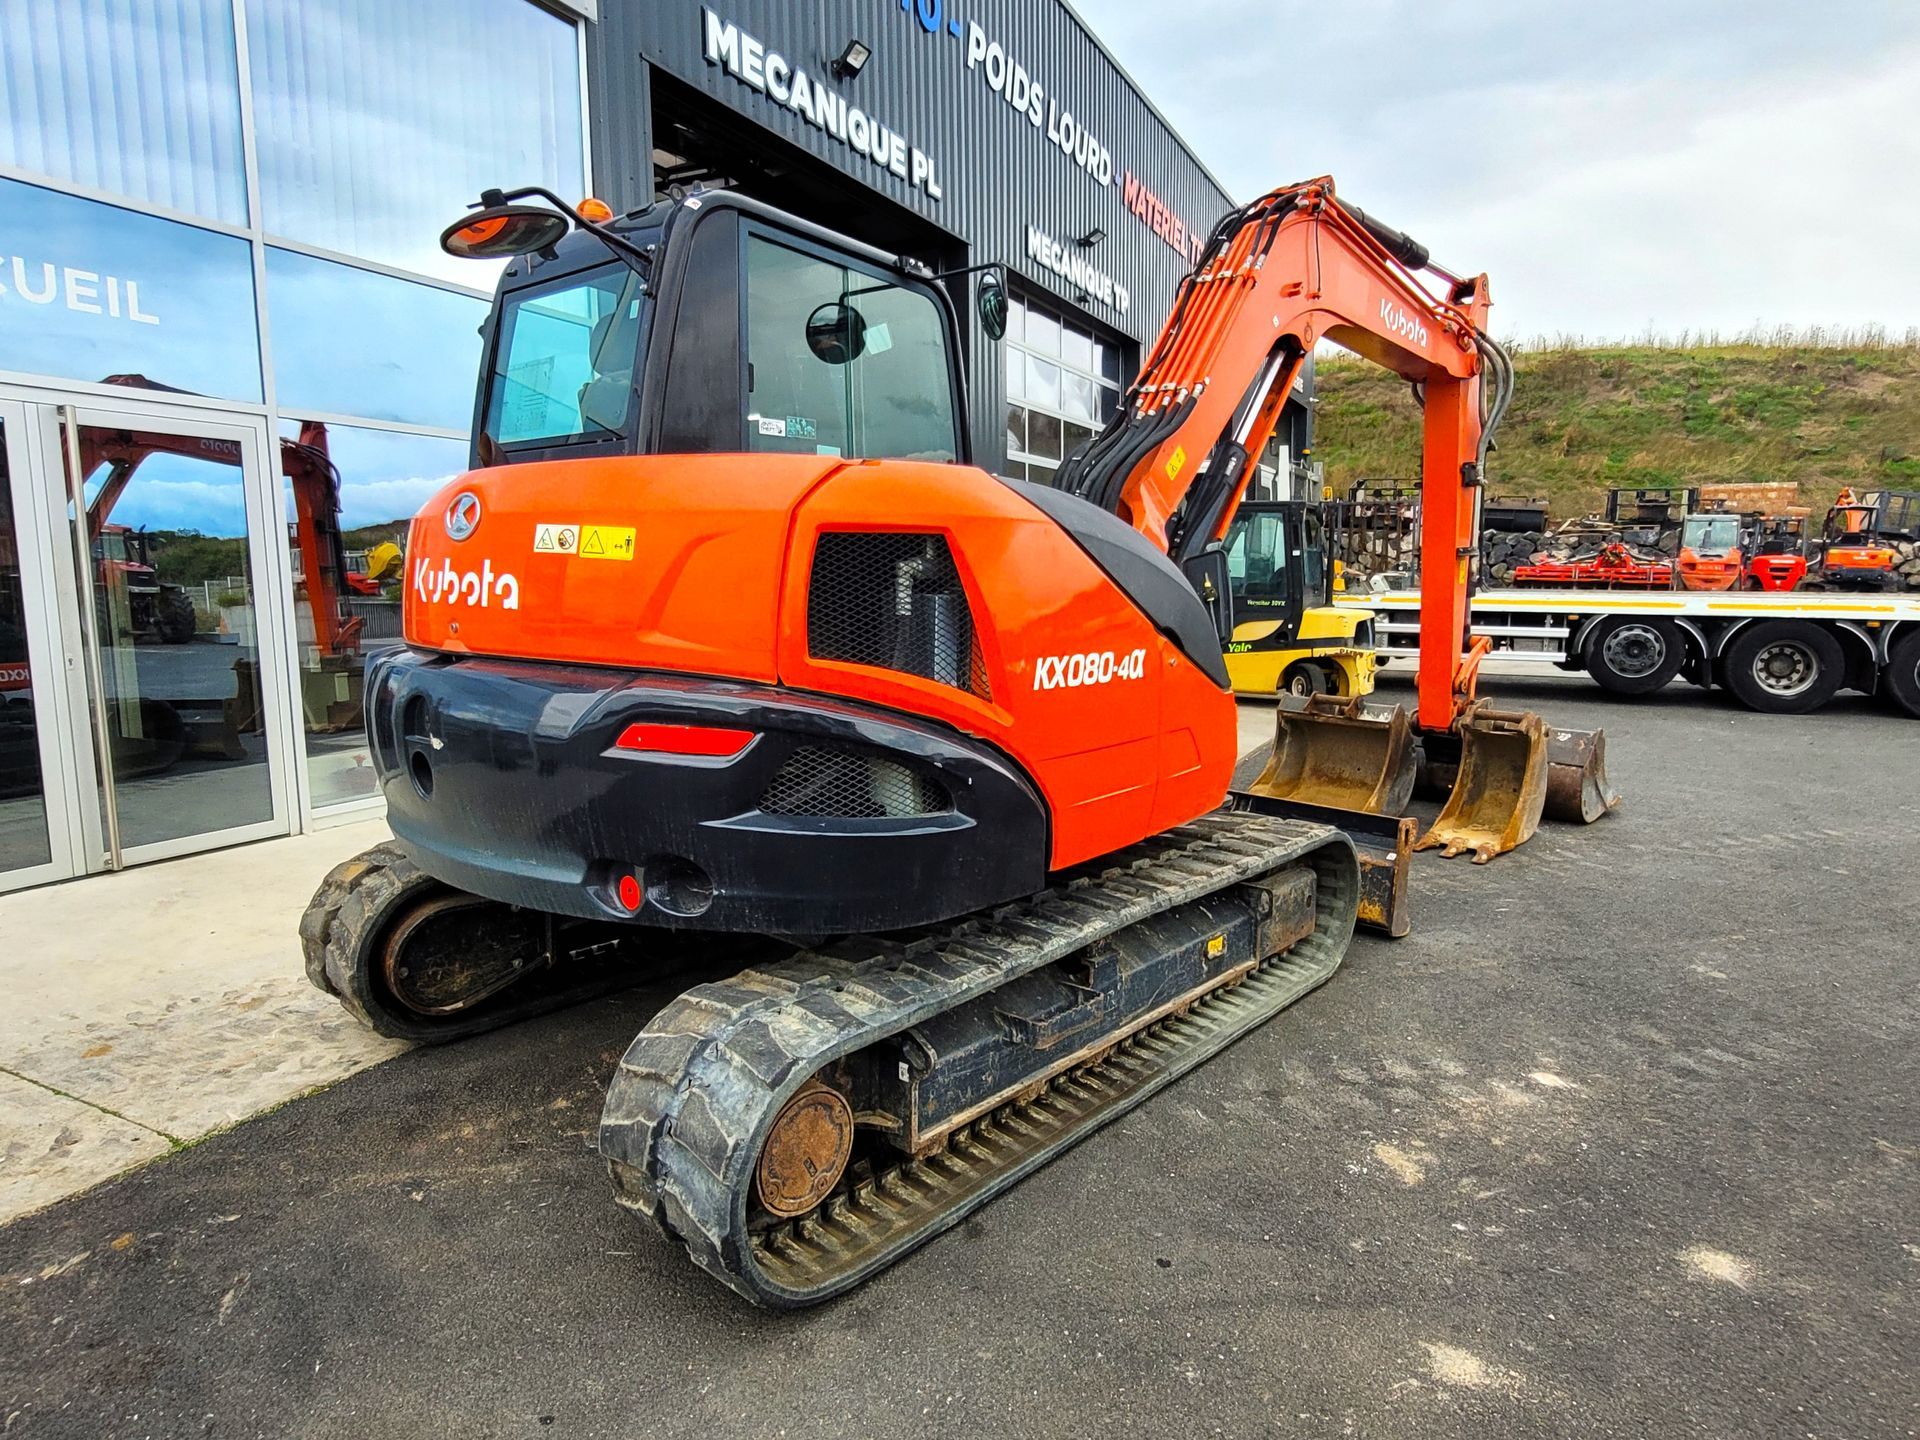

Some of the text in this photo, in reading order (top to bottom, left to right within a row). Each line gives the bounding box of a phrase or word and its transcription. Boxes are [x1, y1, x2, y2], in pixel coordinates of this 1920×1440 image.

[704, 8, 943, 200] MECANIQUE PL
[967, 20, 1044, 127] POIDS
[1047, 97, 1112, 187] LOURD
[1123, 171, 1187, 259] MATERIEL
[0, 256, 160, 325] UEIL
[1027, 225, 1129, 314] MECANIQUE TP
[1380, 298, 1427, 348] Kubota
[414, 558, 519, 610] Kubota
